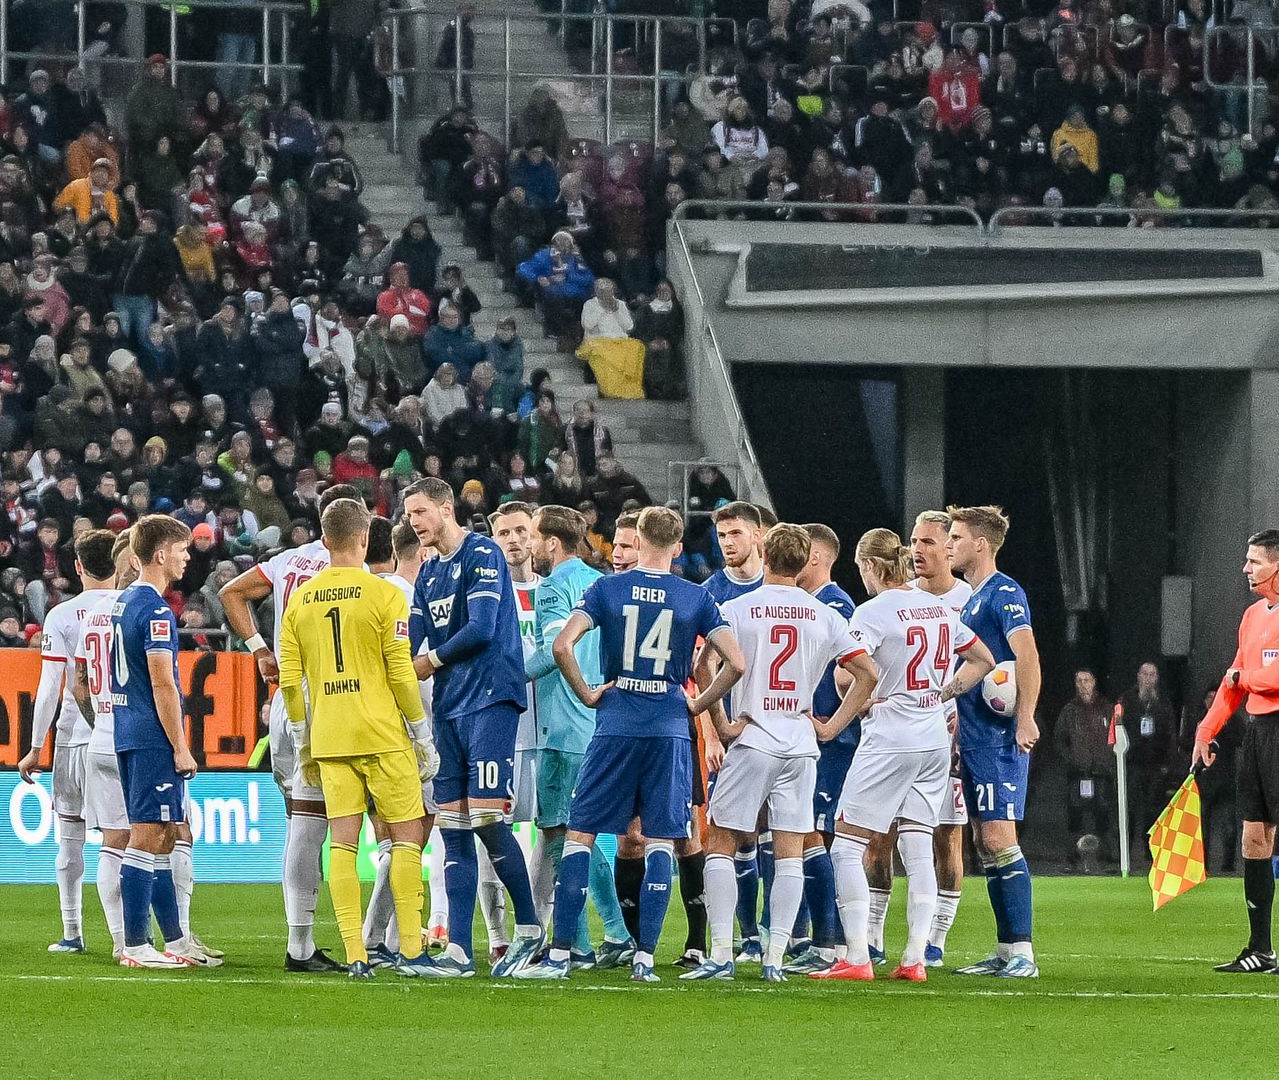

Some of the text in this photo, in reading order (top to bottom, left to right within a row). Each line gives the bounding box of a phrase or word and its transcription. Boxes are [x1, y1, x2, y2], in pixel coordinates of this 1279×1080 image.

[313, 586, 362, 603] AUGSBURG
[631, 585, 666, 604] BEIER
[750, 606, 816, 621] FC AUGSBURG
[324, 606, 344, 673] 1
[622, 604, 674, 676] 14
[769, 624, 798, 691] 2
[906, 623, 951, 691] 24
[324, 678, 360, 696] DAHMEN
[763, 697, 799, 712] GUMNY
[477, 760, 499, 789] 10
[976, 782, 995, 812] 21
[647, 882, 668, 891] TSG
